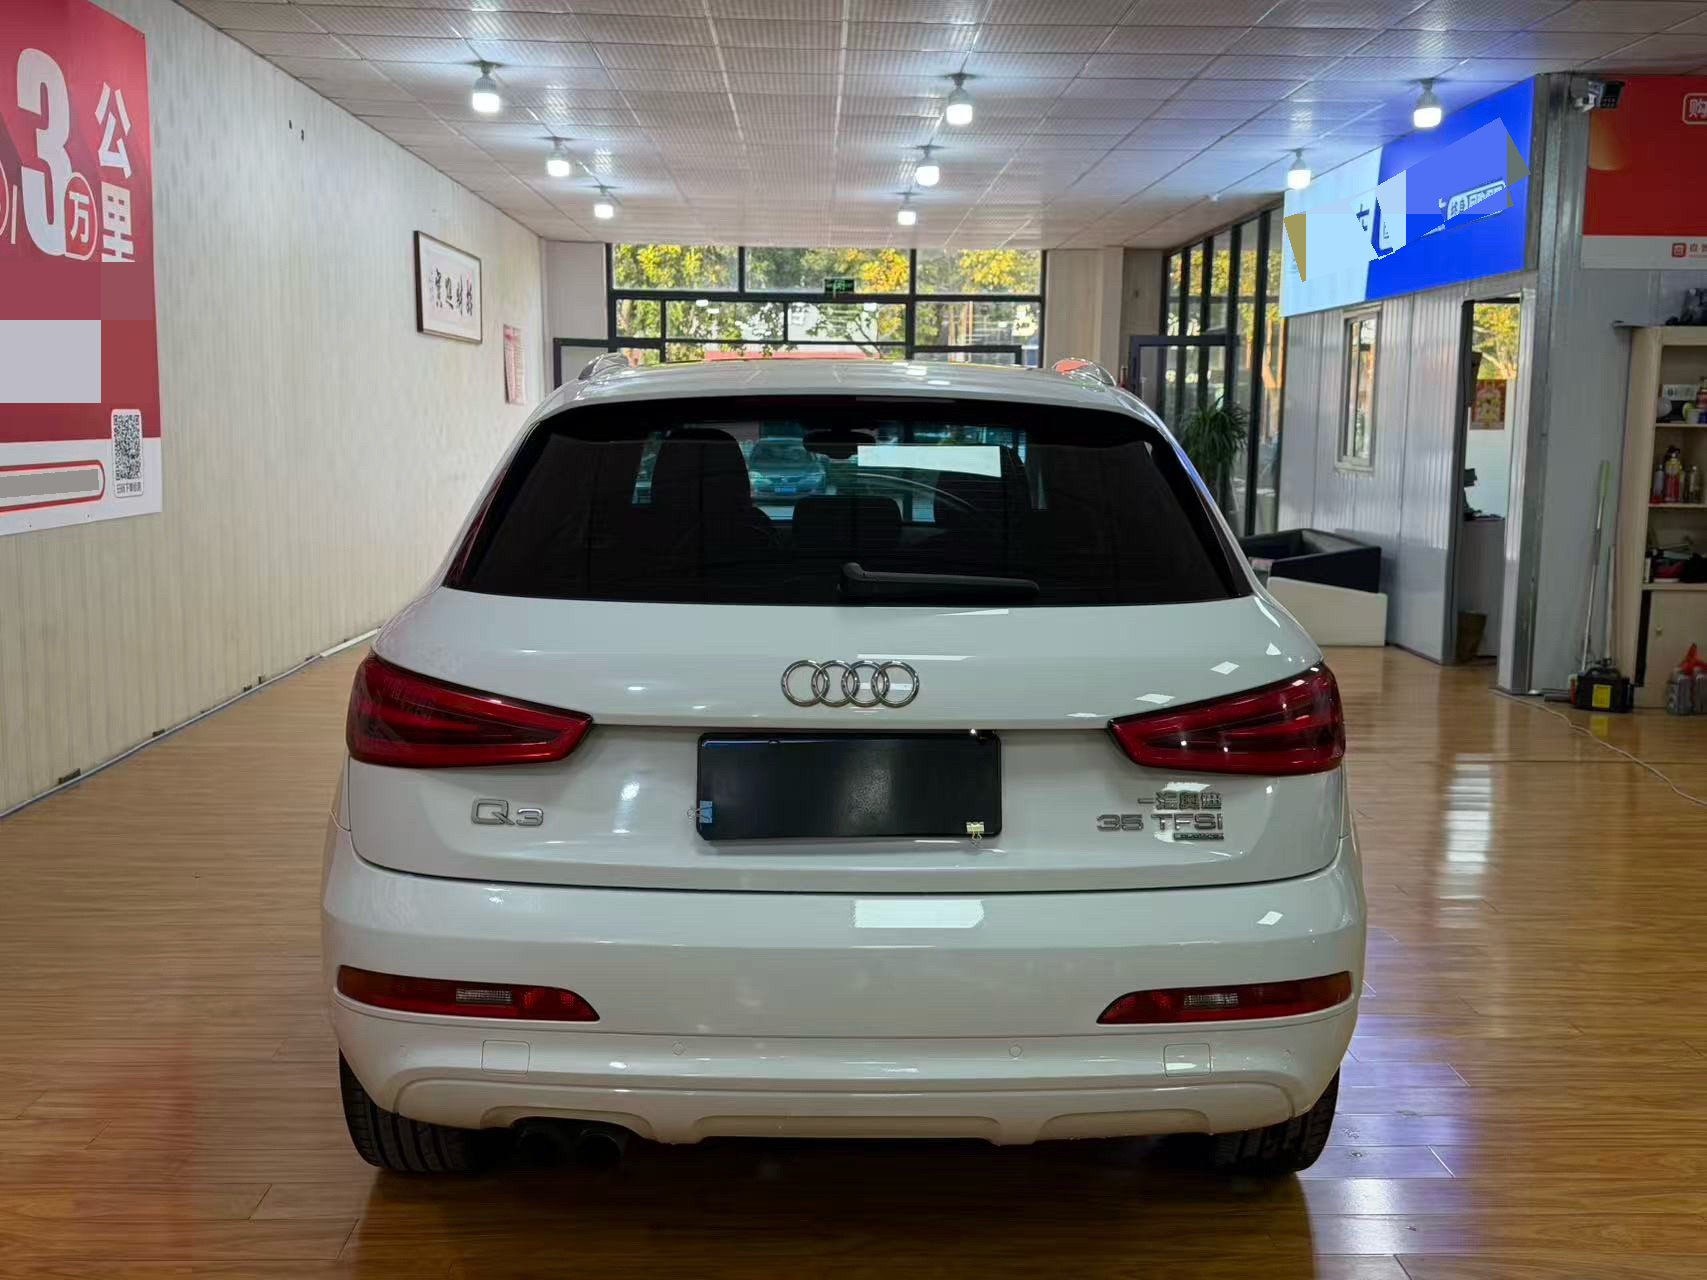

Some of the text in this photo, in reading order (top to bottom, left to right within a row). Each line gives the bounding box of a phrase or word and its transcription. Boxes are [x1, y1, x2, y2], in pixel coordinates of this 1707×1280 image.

[471, 798, 544, 826] Q3
[1096, 813, 1223, 831] 35 TFSI
